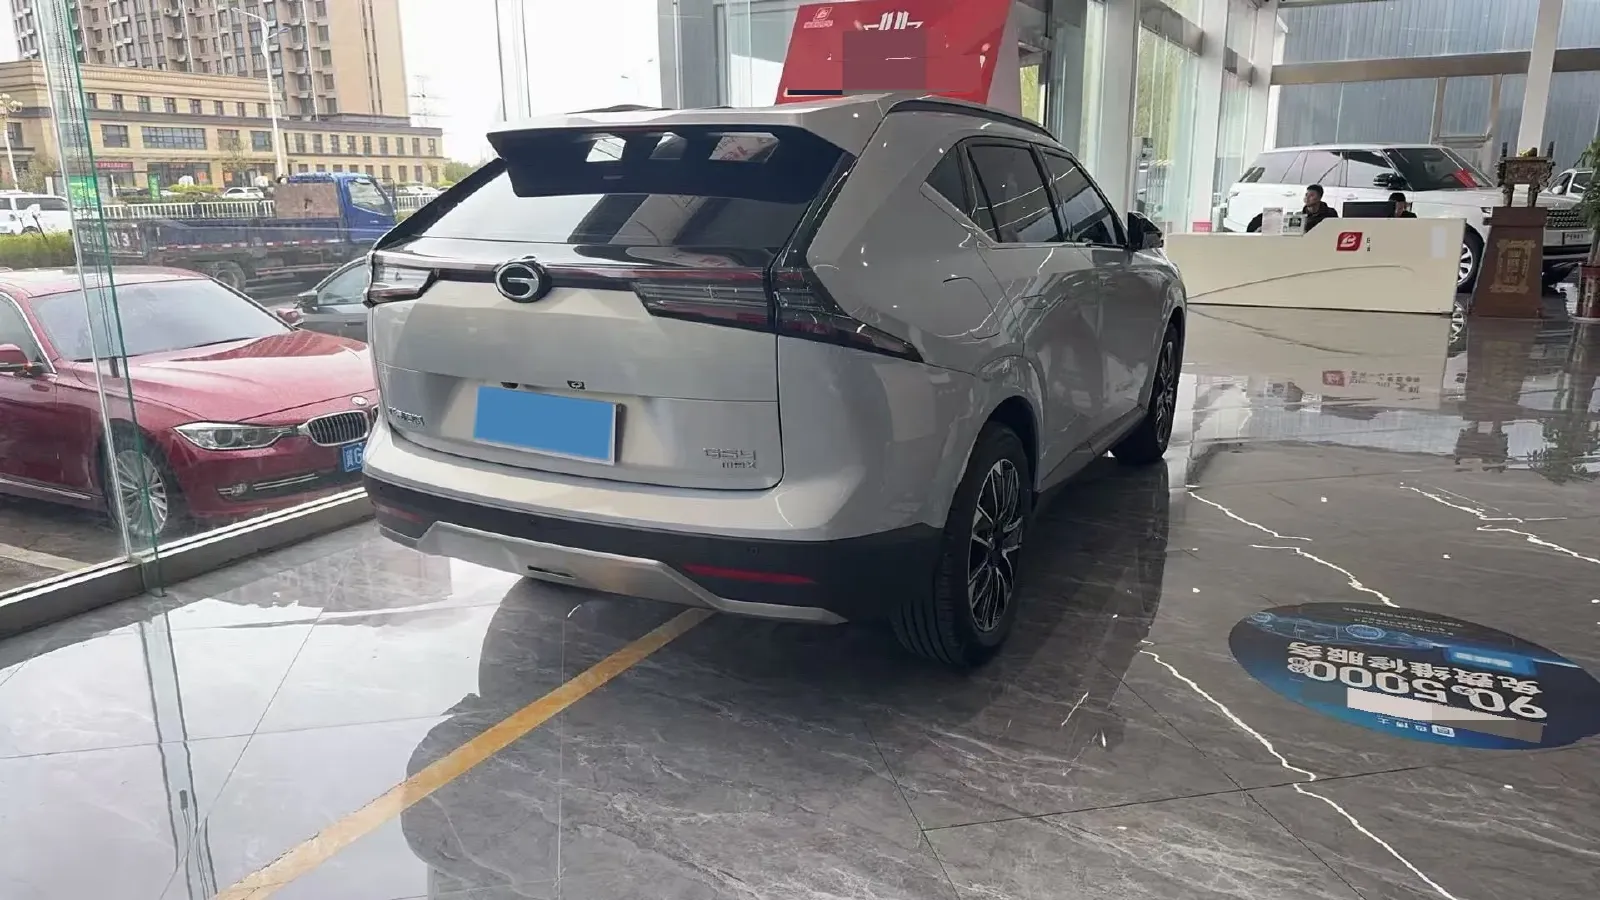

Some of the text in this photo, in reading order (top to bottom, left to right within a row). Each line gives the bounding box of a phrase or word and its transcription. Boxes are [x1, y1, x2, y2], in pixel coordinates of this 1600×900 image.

[1287, 641, 1543, 696] 免费维修服务
